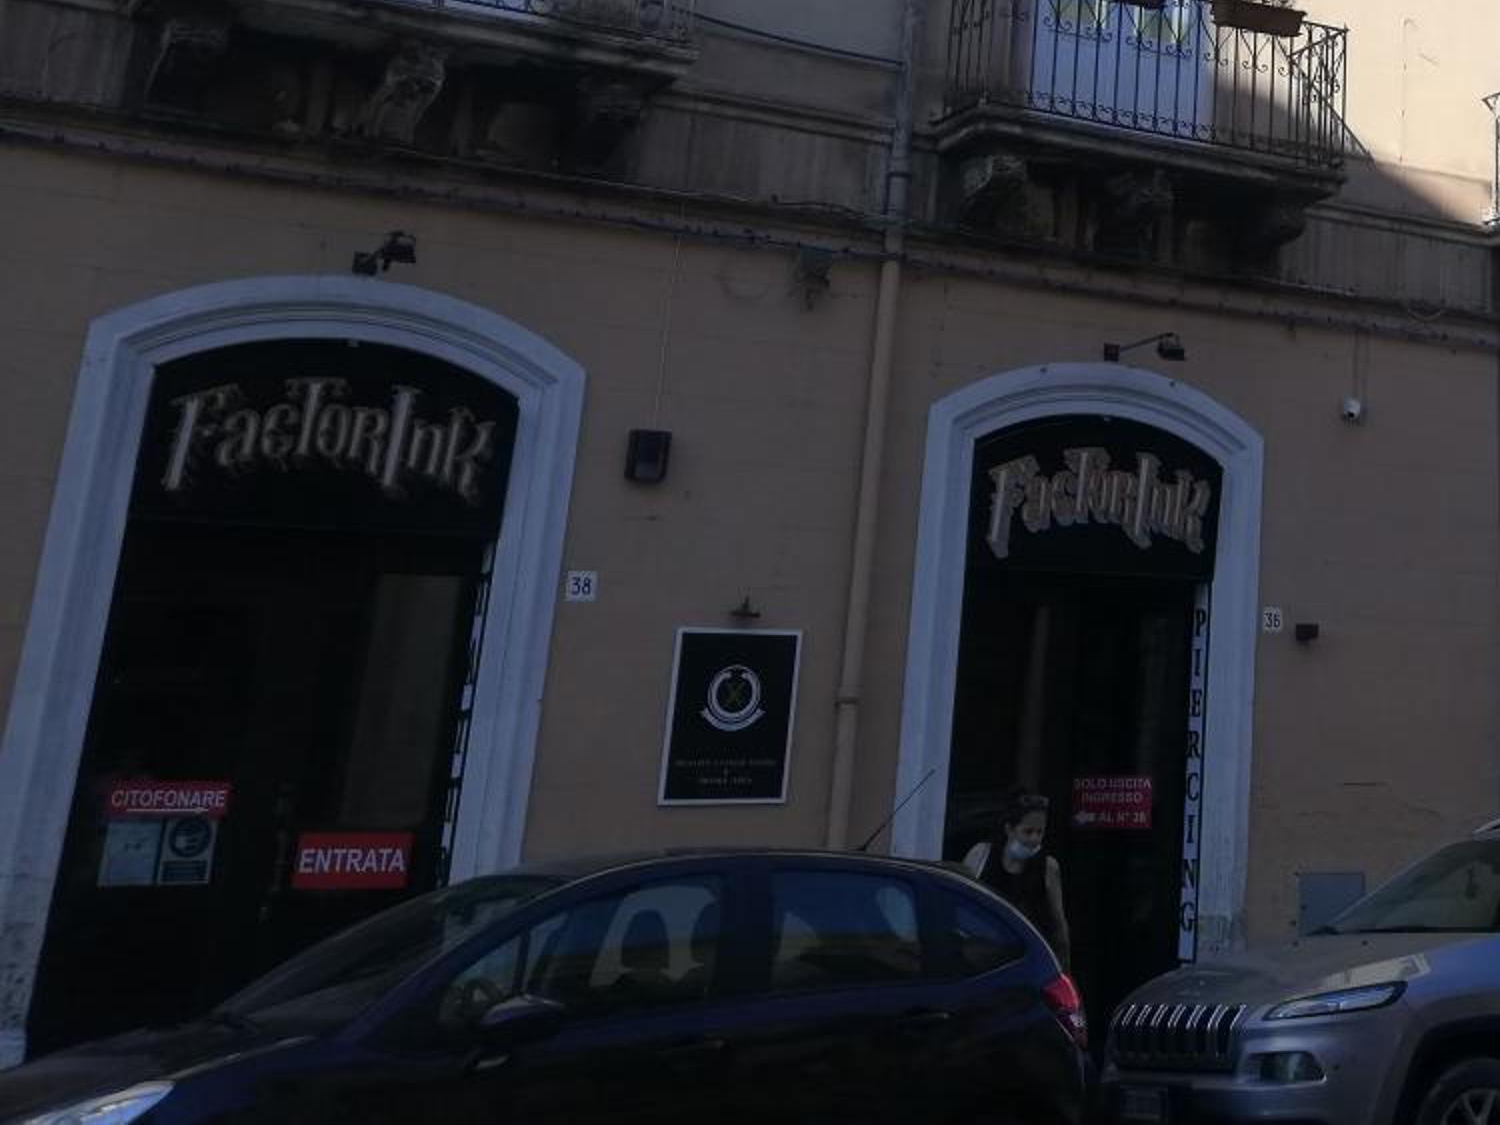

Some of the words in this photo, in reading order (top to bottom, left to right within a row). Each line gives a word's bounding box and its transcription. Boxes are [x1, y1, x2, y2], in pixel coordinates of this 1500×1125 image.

[571, 576, 592, 596] 38
[1265, 612, 1281, 628] 36
[1181, 608, 1208, 933] PIERCING
[1072, 777, 1107, 790] SOLO
[1109, 778, 1152, 789] USCITA
[110, 788, 227, 808] CITOFONARE
[298, 847, 406, 874] ENTRATA
